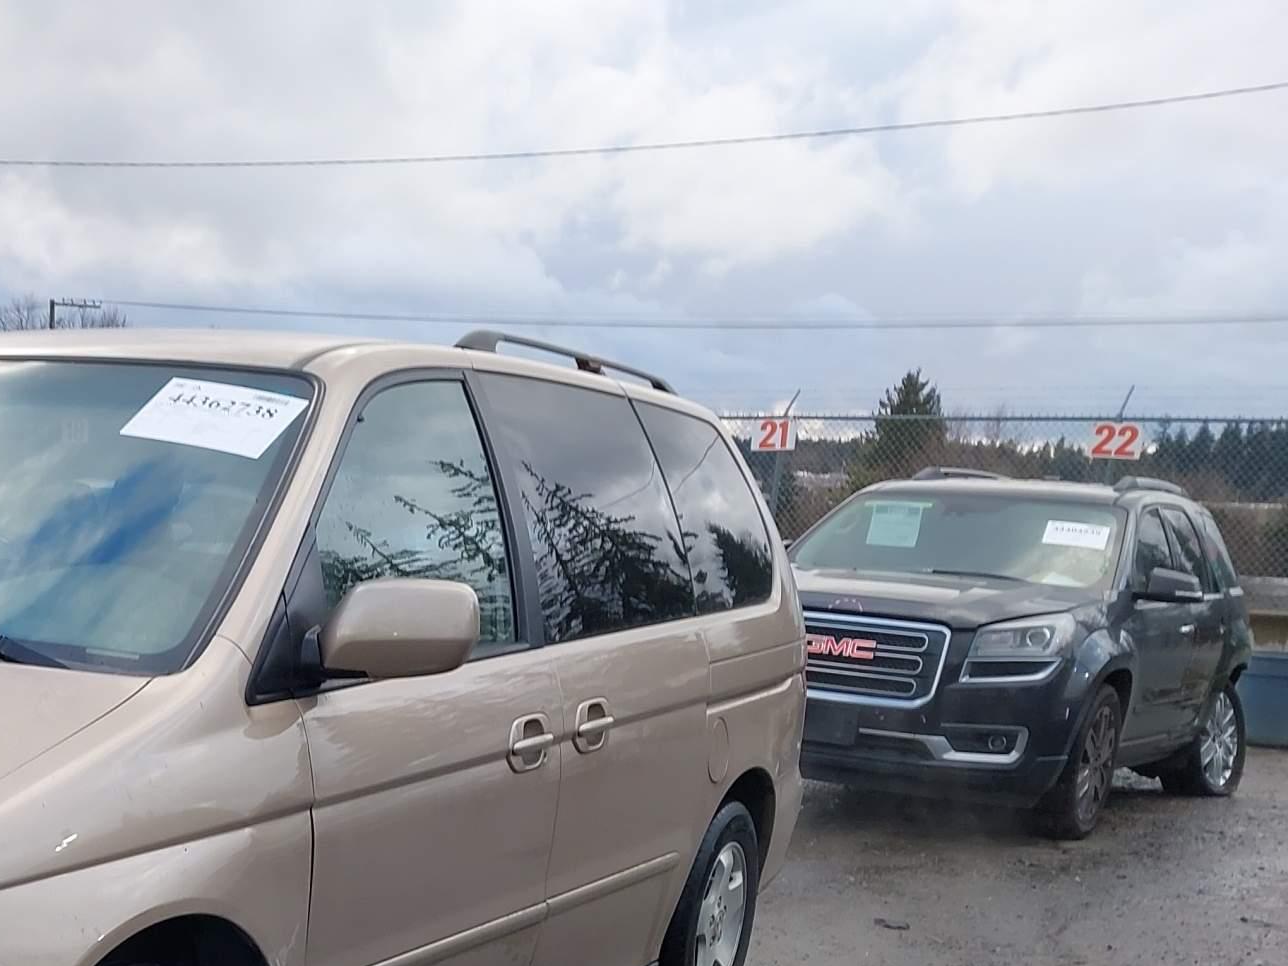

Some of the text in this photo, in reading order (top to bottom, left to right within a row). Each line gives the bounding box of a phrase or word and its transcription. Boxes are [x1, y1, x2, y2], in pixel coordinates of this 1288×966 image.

[759, 420, 789, 449] 21
[1092, 424, 1139, 456] 22
[805, 633, 877, 660] GMC
